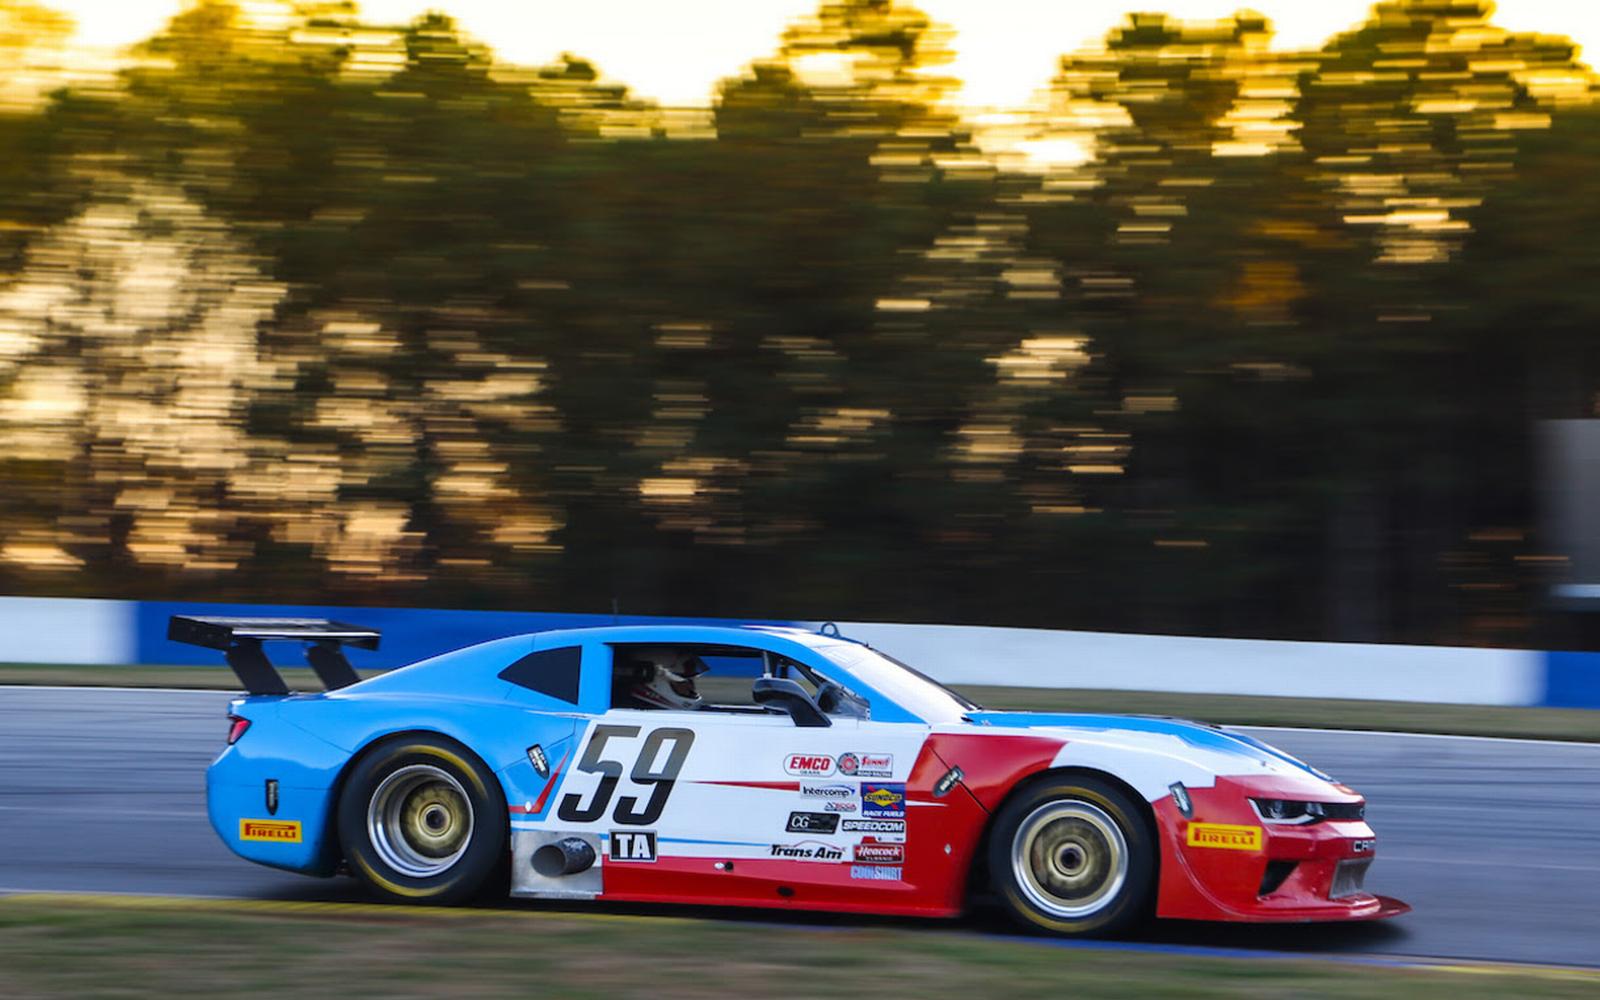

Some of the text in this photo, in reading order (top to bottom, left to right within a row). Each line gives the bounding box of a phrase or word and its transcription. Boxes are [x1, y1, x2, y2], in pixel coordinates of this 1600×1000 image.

[790, 757, 831, 771] EMCO
[557, 724, 695, 826] 59
[803, 786, 850, 798] Intercomp
[864, 793, 902, 803] SUNOCO
[245, 823, 297, 839] PIRELLI
[843, 821, 904, 833] SPEEDCOM
[1193, 827, 1255, 846] PIRELLI
[615, 834, 651, 858] TA
[770, 844, 843, 860] Trans Am
[857, 846, 900, 857] Heacock
